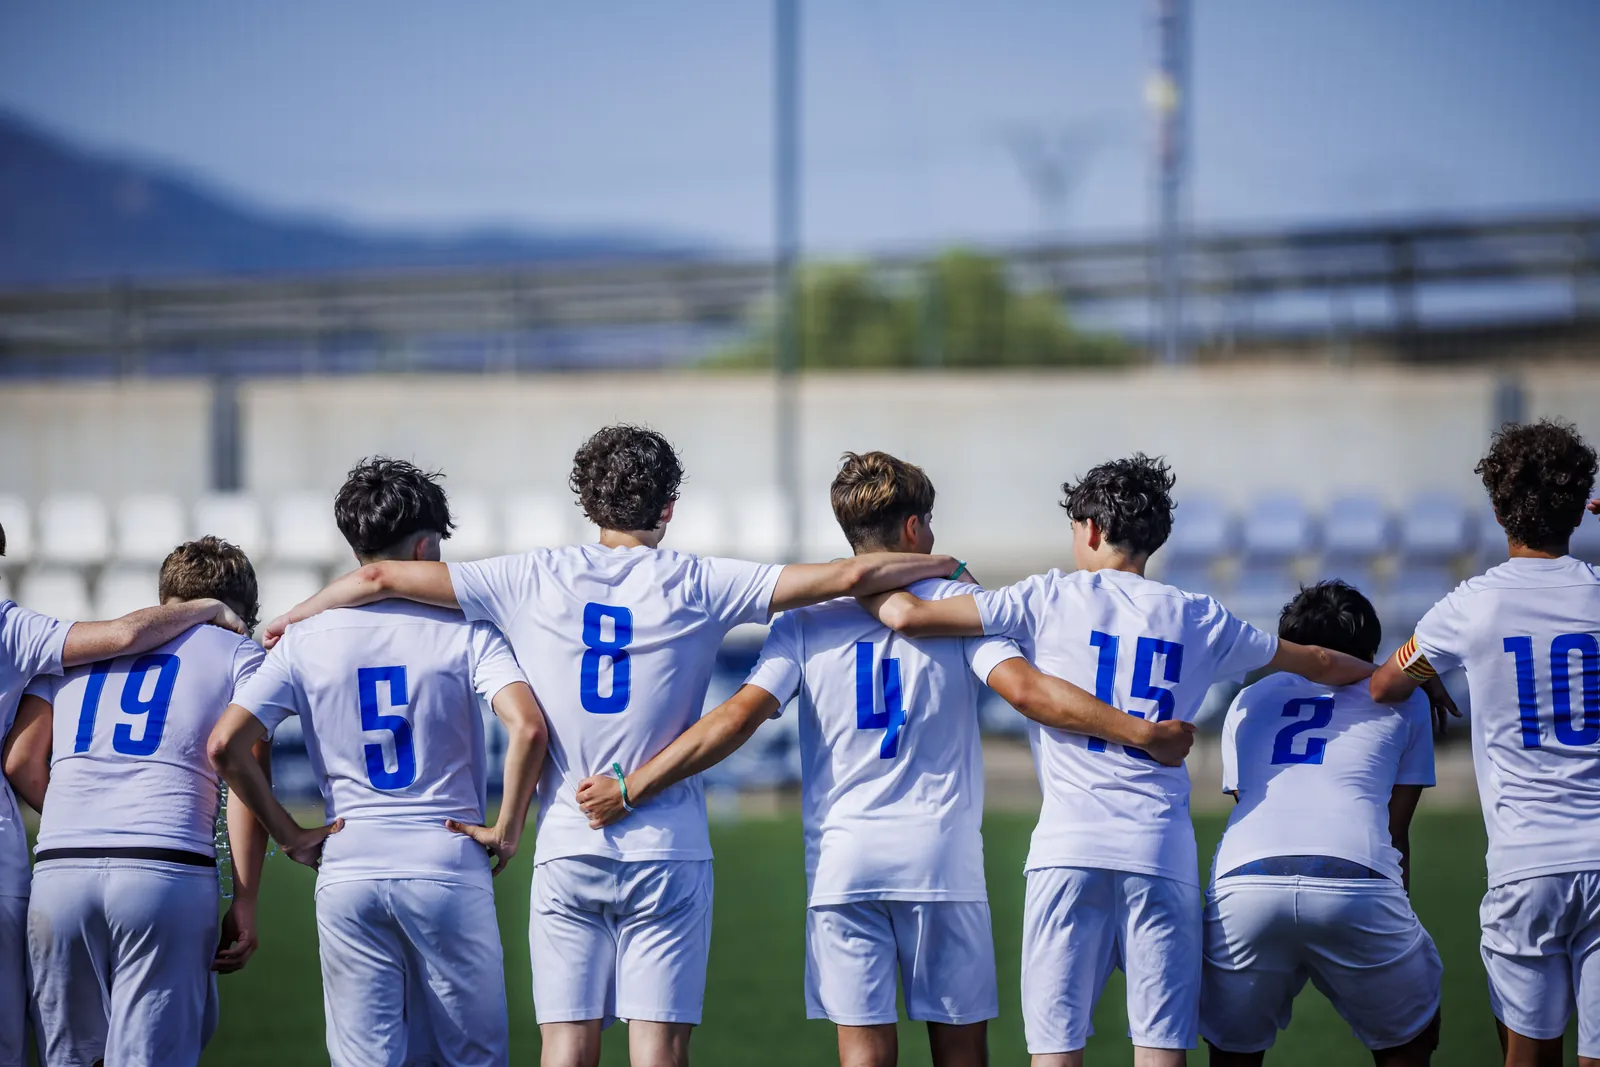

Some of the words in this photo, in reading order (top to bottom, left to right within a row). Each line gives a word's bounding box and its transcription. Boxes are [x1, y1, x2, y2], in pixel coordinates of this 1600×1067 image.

[74, 653, 180, 756] 19
[580, 602, 633, 714] 8
[856, 642, 907, 759] 4
[1088, 630, 1185, 760] 15
[1503, 633, 1600, 749] 10
[358, 665, 416, 790] 5
[1270, 697, 1336, 765] 2
